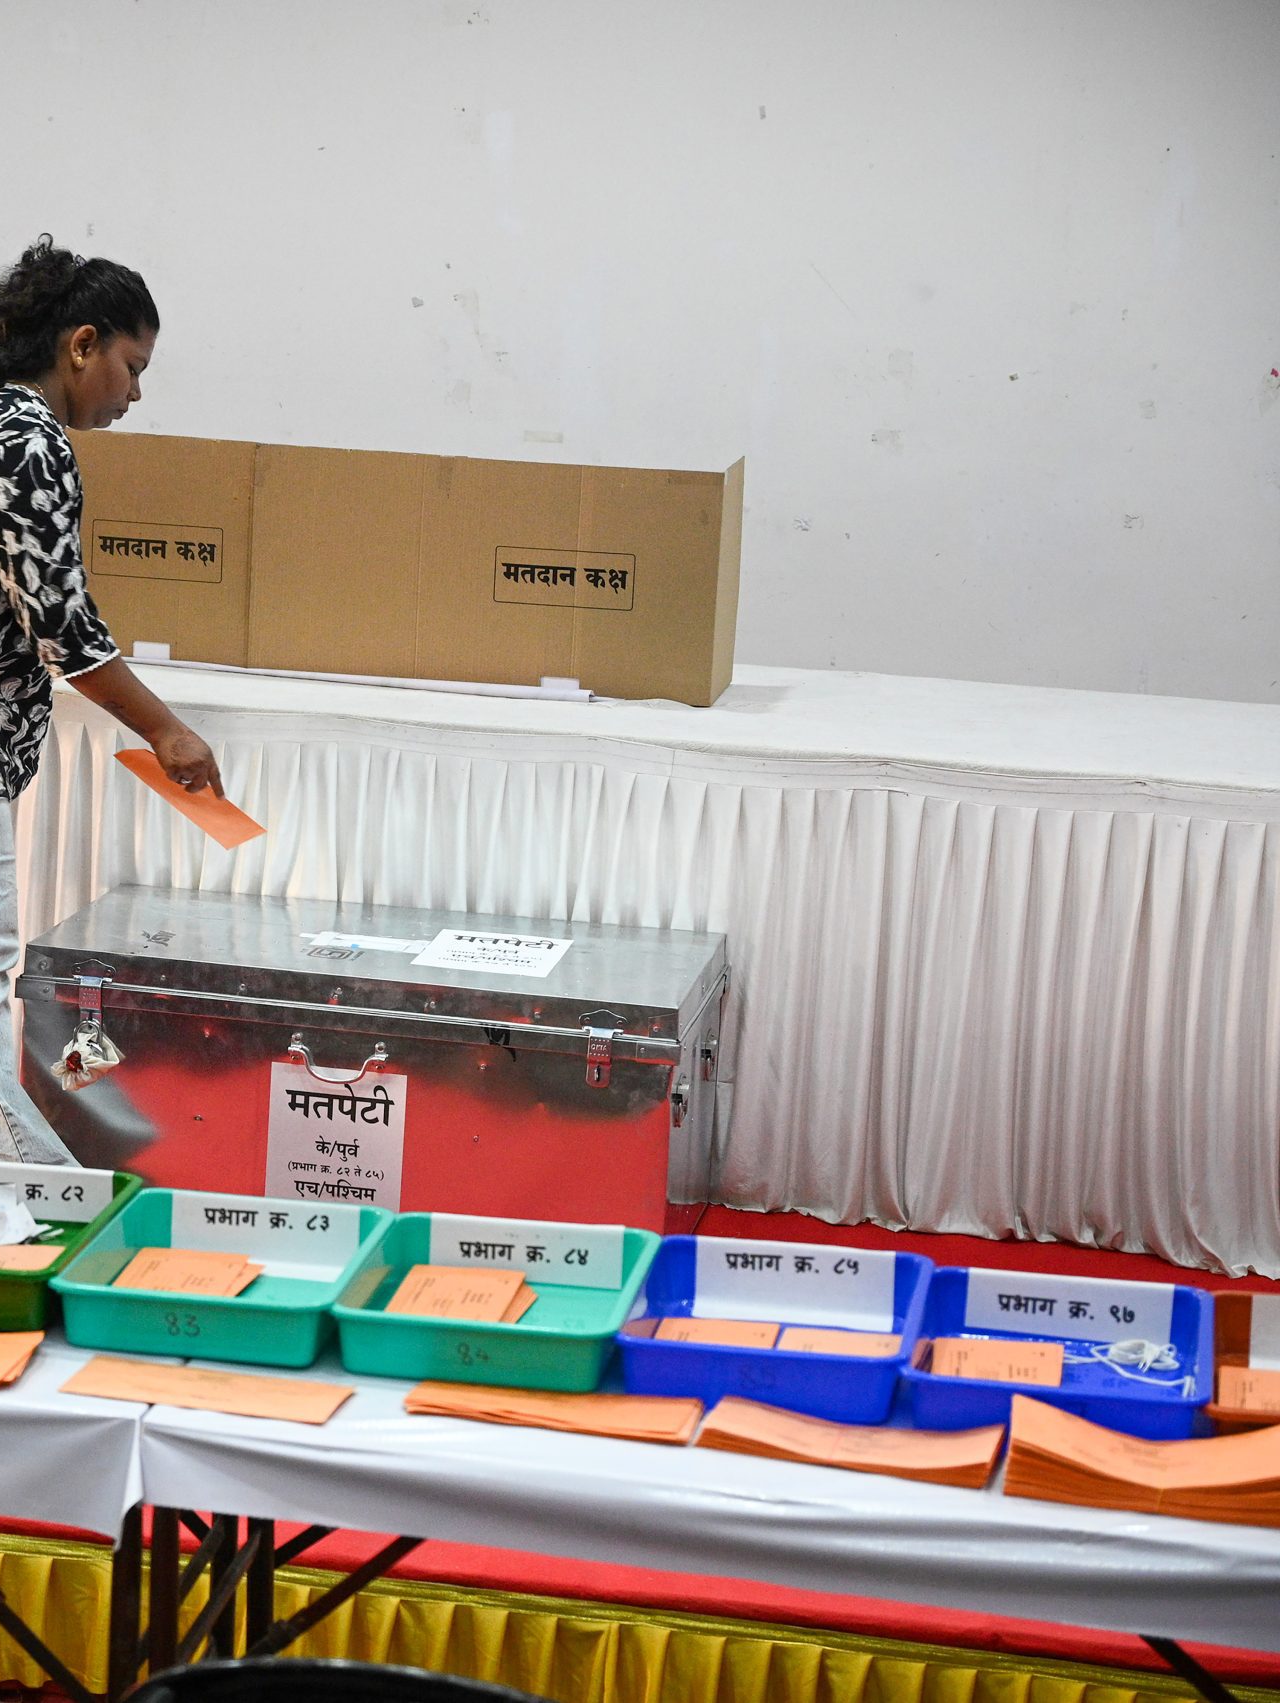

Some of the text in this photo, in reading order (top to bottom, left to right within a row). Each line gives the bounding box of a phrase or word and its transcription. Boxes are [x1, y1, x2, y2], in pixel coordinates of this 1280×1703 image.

[98, 536, 217, 567] मतदान कक्ष
[501, 563, 629, 594] मतदान कक्ष
[285, 1083, 395, 1127] मतपेटी
[315, 1135, 360, 1161] के/पुर्व
[288, 1160, 385, 1181] (प्रभाग क्र. ८२ ते ८५)
[25, 1183, 49, 1201] क्र.
[61, 1186, 84, 1202] ८२
[294, 1179, 376, 1201] एच/पश्चिम
[204, 1207, 331, 1232] प्रभाग क्र. ८३
[459, 1241, 589, 1265] प्रभाग क्र. ८४
[725, 1253, 859, 1275] प्रभाग क्र. ८५
[997, 1293, 1135, 1324] प्रभाग क्र. ९७
[165, 1311, 201, 1338] 83
